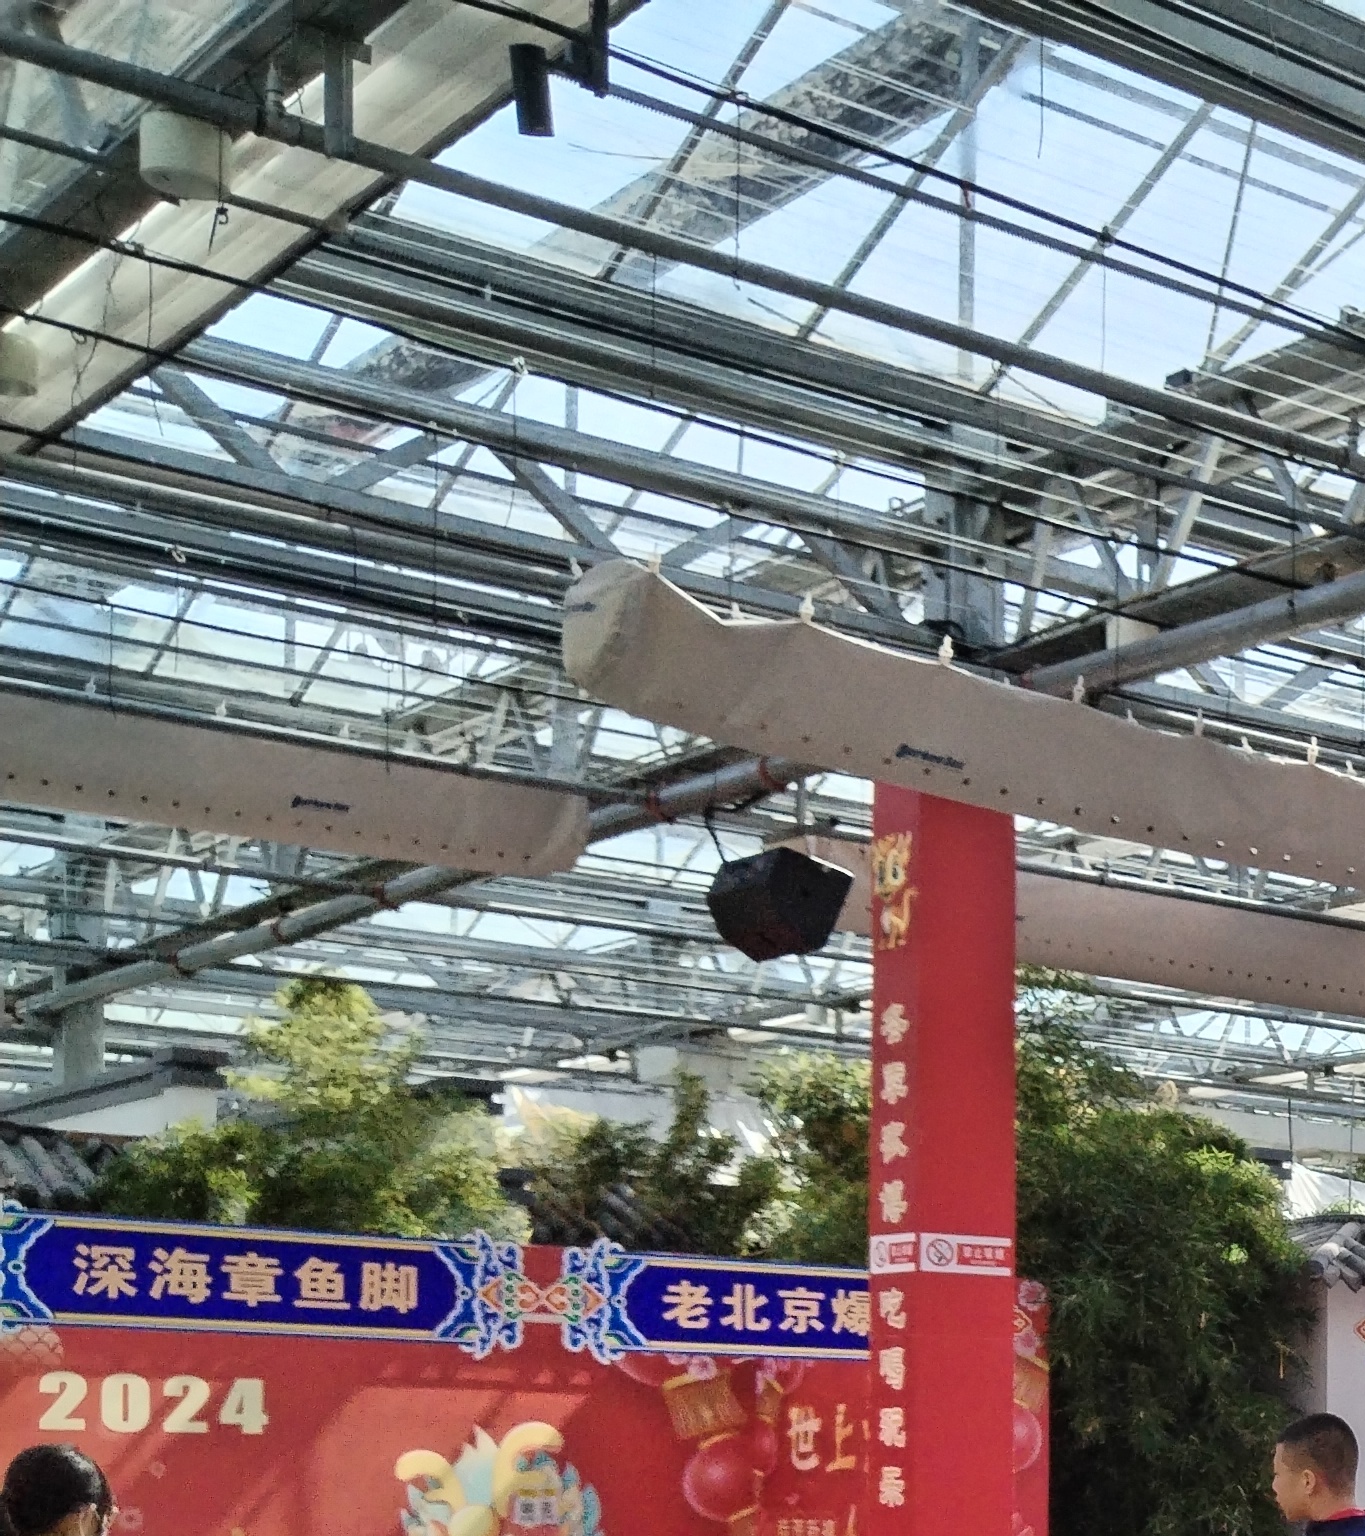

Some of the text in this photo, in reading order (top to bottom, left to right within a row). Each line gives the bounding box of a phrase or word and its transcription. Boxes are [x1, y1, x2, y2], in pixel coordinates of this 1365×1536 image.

[72, 1243, 420, 1315] 深海章鱼脚
[39, 1371, 270, 1436] 2024
[788, 1403, 871, 1473] 世上
